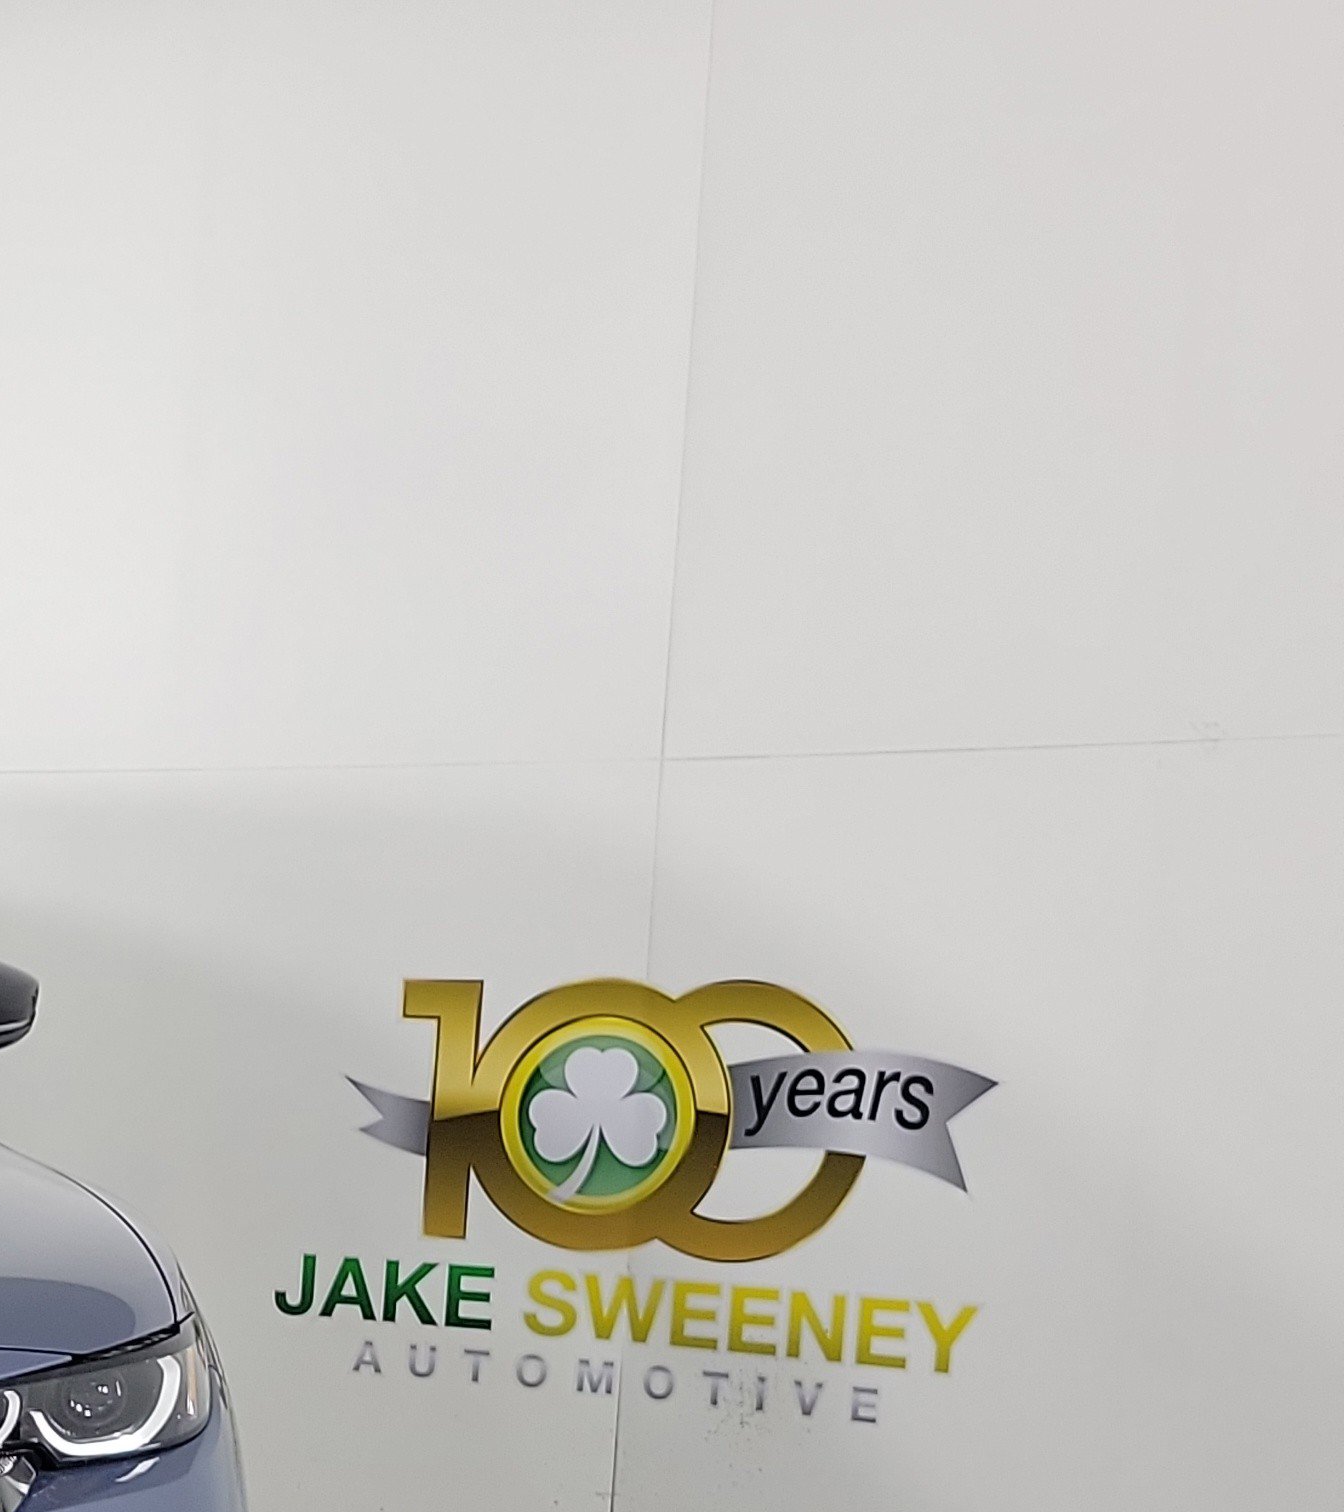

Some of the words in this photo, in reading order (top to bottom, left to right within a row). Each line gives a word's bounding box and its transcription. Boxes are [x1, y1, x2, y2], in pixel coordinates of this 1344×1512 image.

[403, 977, 866, 1262] 100
[744, 1067, 935, 1137] years
[273, 1253, 496, 1331] JAKE
[523, 1269, 979, 1374] SWEENEY
[352, 1340, 880, 1424] AUTOMOTIVE
